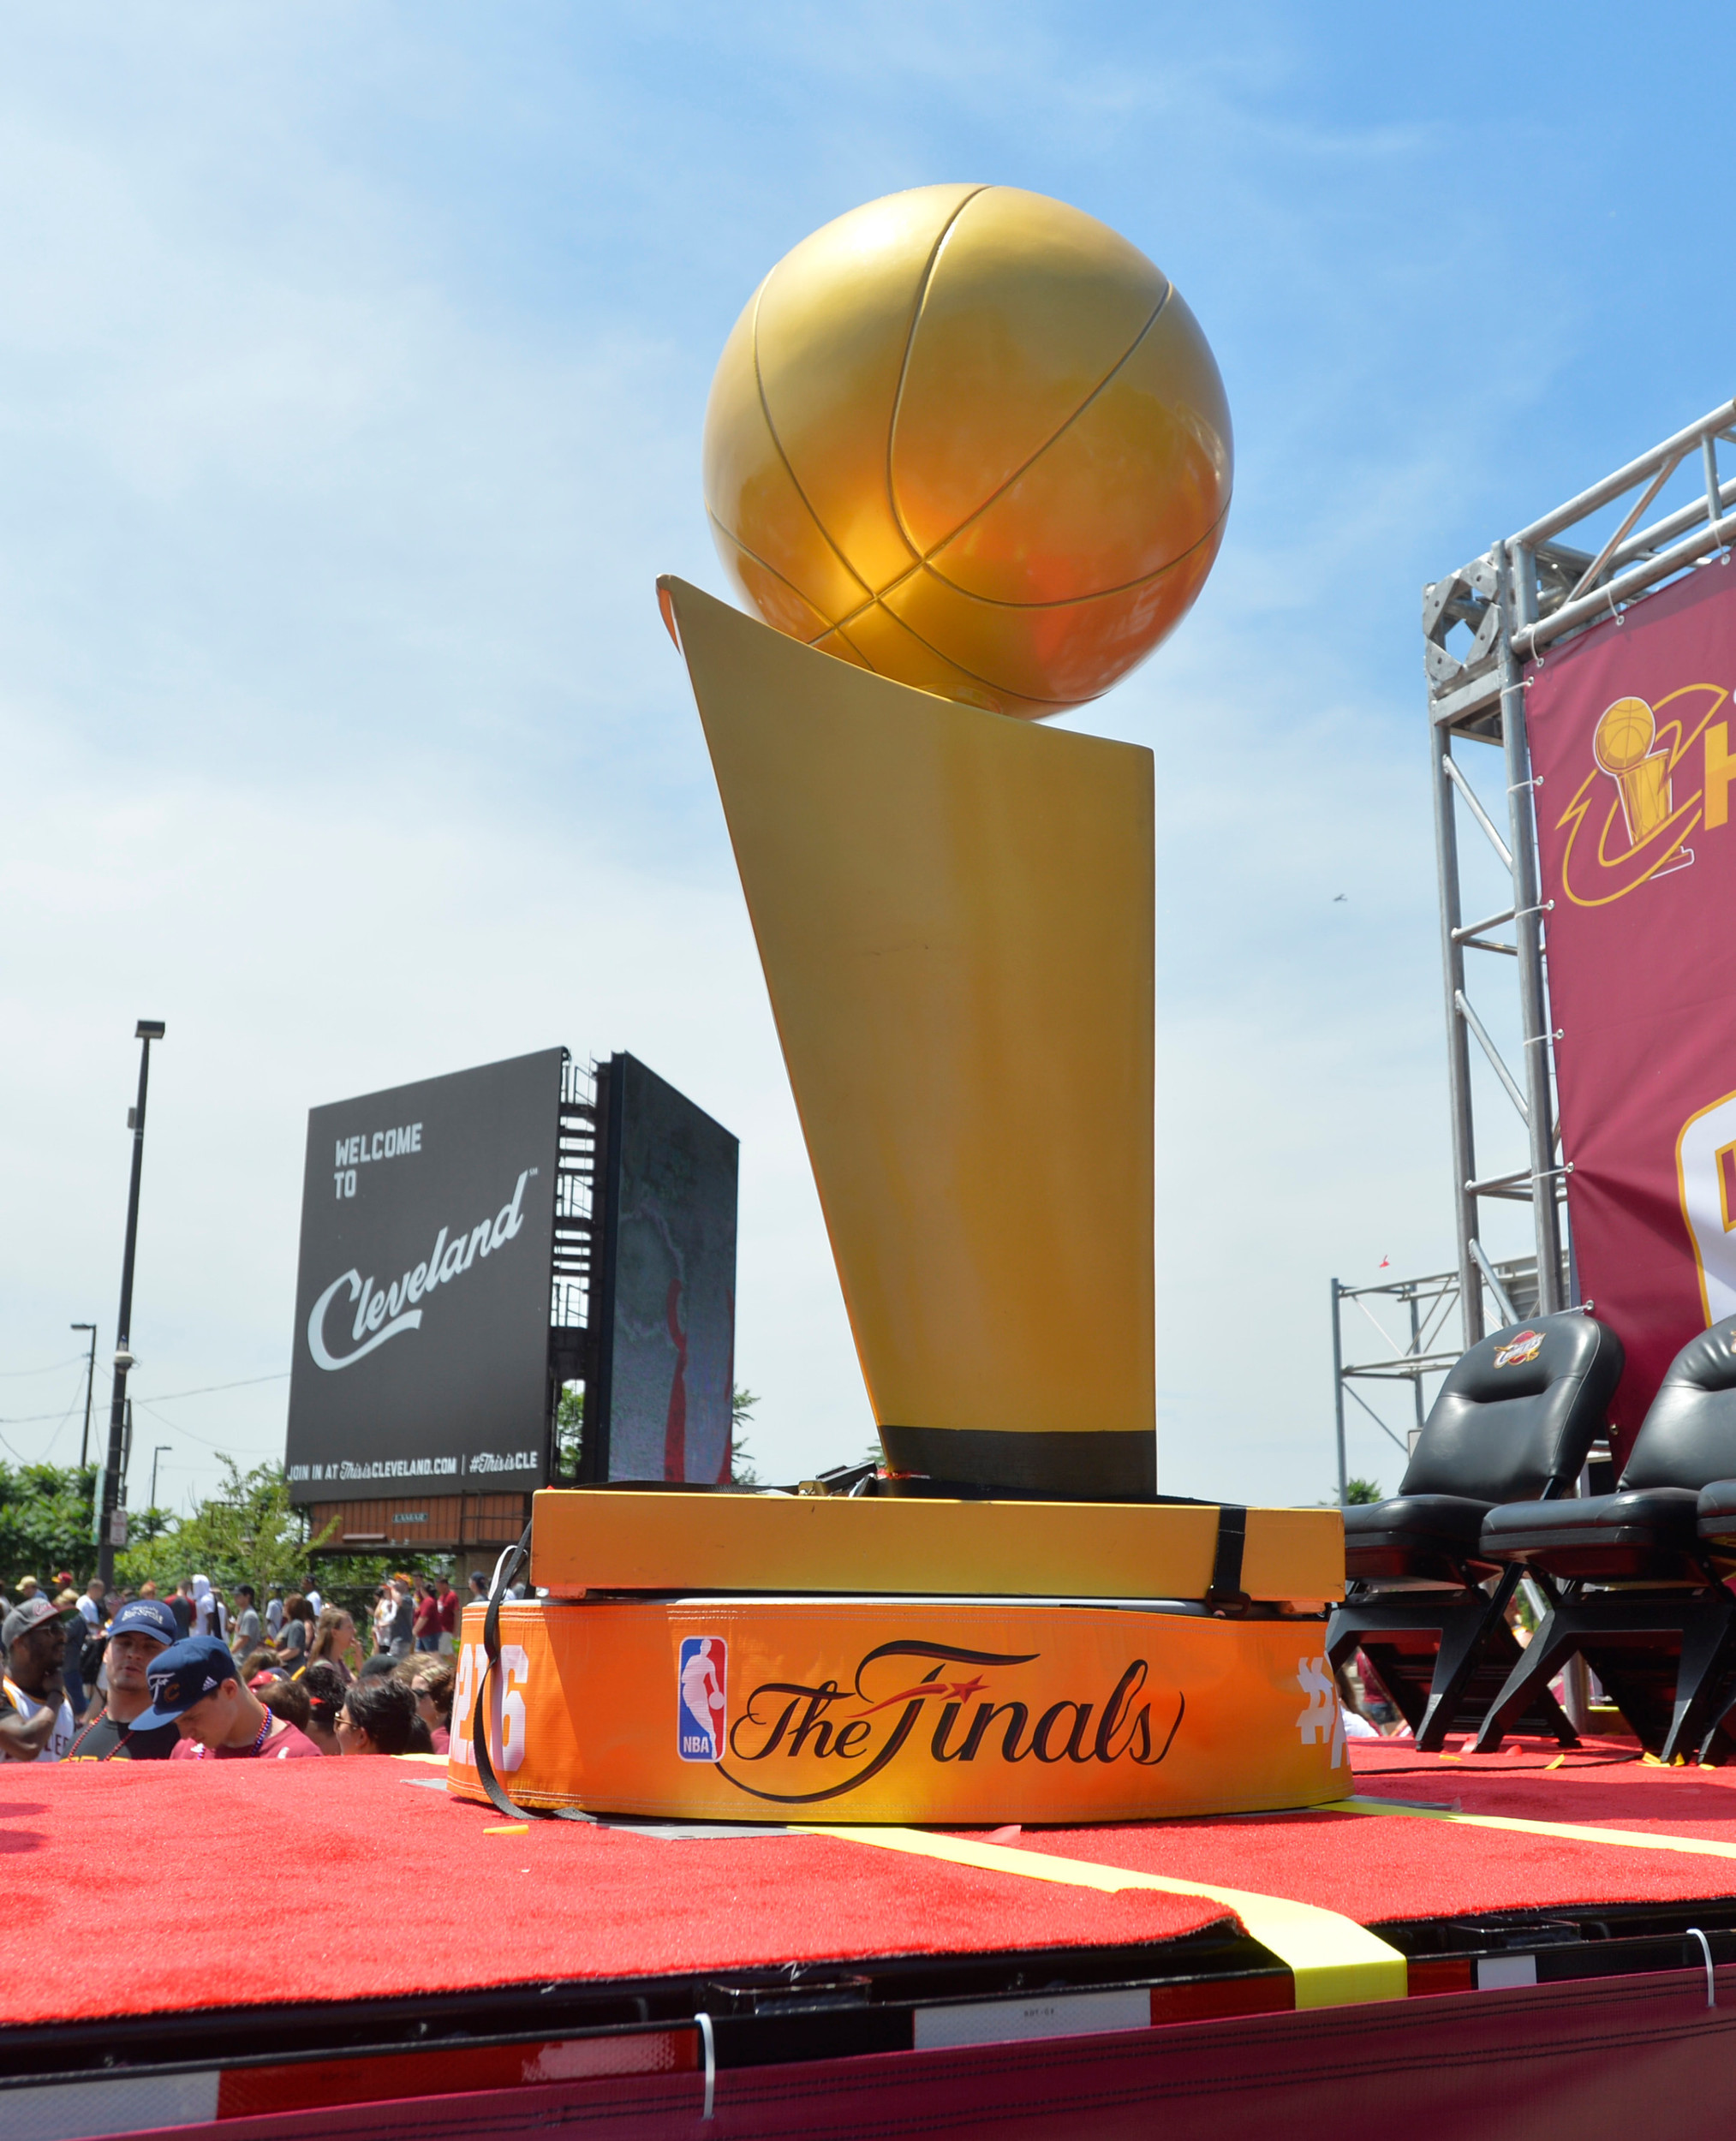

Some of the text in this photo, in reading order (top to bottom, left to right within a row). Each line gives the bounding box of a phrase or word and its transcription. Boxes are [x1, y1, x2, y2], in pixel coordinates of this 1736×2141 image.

[336, 1122, 423, 1167] WELCOME
[334, 1169, 356, 1200] TO
[307, 1170, 528, 1371] Cleveland
[287, 1464, 309, 1482] JOIN
[313, 1464, 322, 1480] IN
[325, 1464, 339, 1480] AT
[716, 1640, 1185, 1804] The Finals
[683, 1735, 711, 1754] NBA
